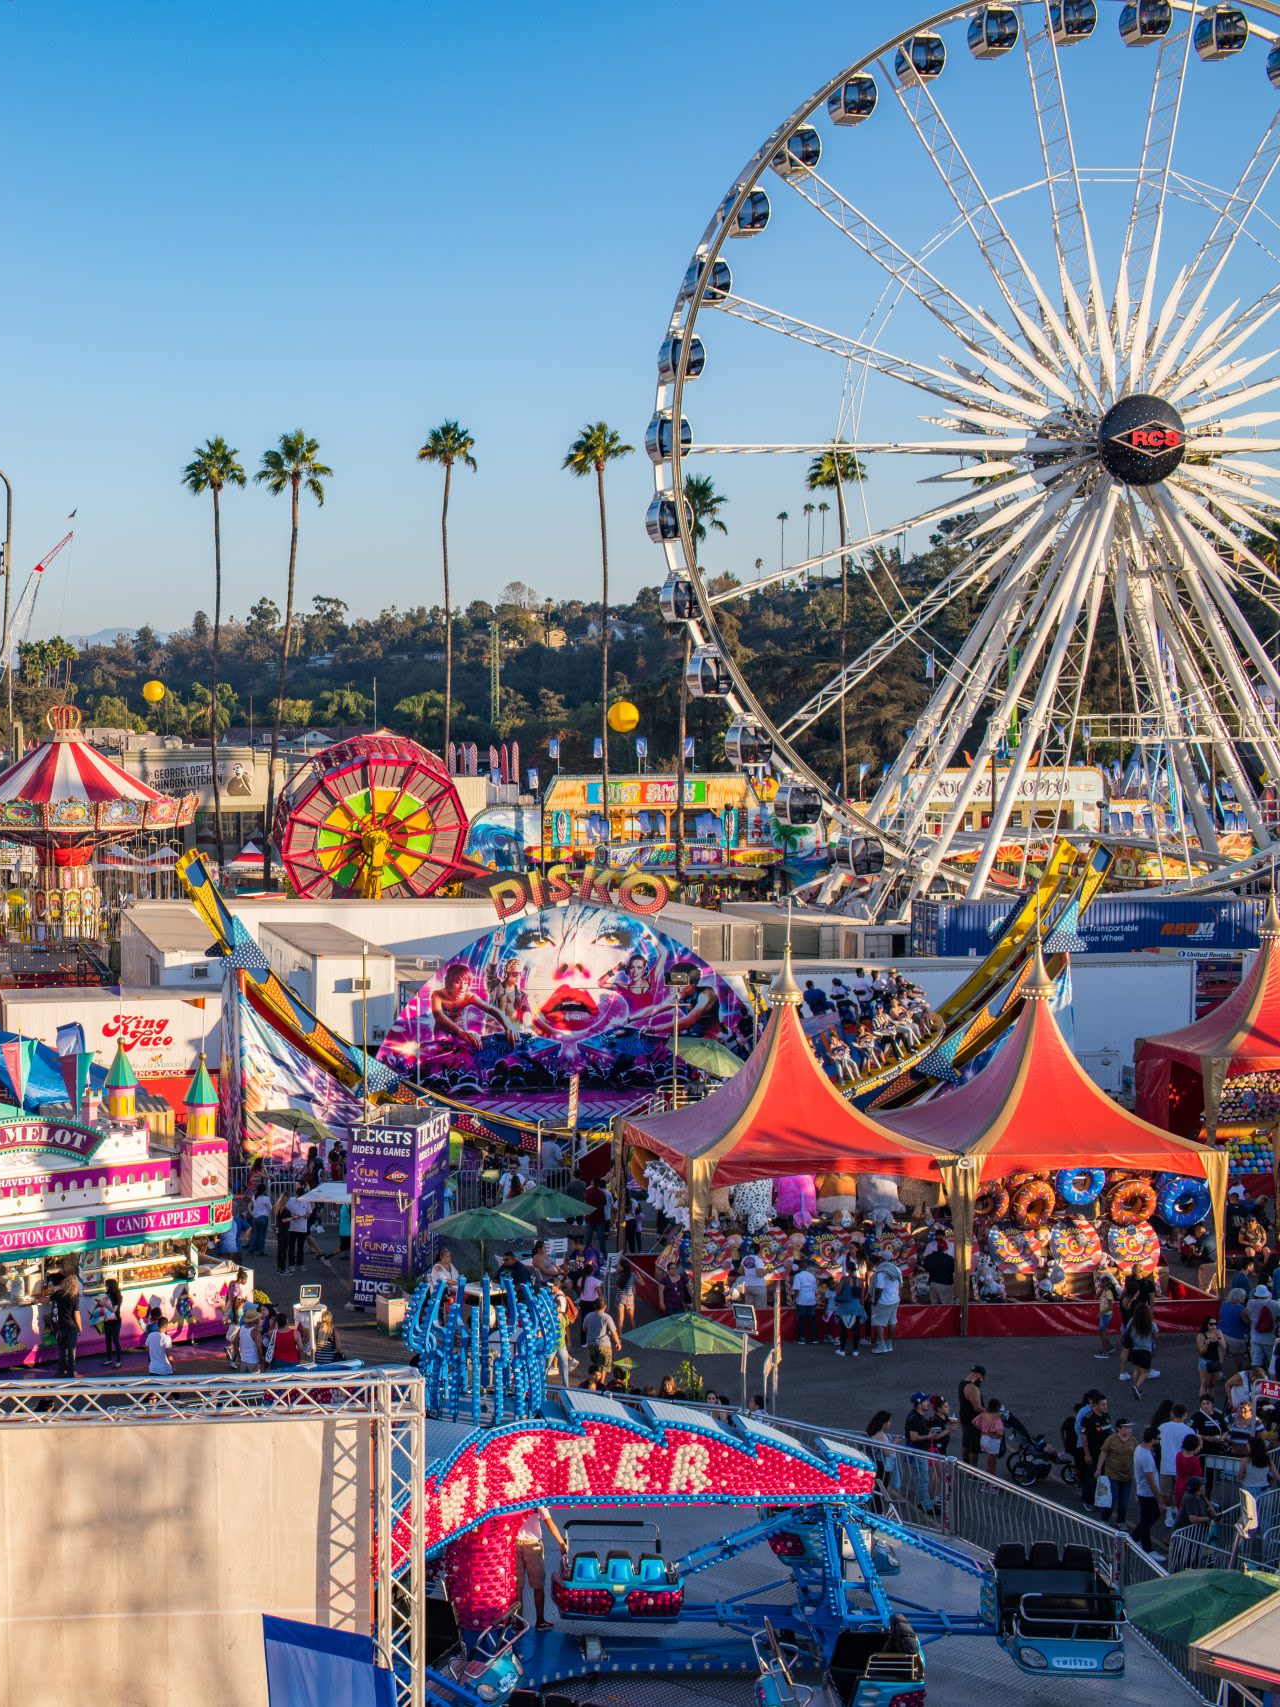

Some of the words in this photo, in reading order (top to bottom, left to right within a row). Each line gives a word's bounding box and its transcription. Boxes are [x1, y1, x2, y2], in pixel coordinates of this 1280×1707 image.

[1133, 431, 1180, 447] RCS
[154, 768, 185, 780] GEORGE
[149, 776, 186, 791] CHINGON
[598, 782, 641, 802] SURF
[489, 863, 669, 920] DISKO
[1090, 924, 1139, 934] Transportable
[1102, 934, 1124, 942] Wheel
[102, 1014, 170, 1038] King
[123, 1030, 173, 1052] Taco
[418, 1113, 450, 1149] TICKETS
[352, 1145, 374, 1155] RIDES
[383, 1148, 410, 1158] GAMES
[360, 1168, 379, 1177] FUN
[34, 1175, 52, 1184] ICE
[116, 1216, 156, 1232] CANDY
[159, 1210, 201, 1227] APPLES
[41, 1225, 86, 1242] CANDY
[1061, 1228, 1083, 1236] BANK
[816, 1233, 838, 1244] BANK
[364, 1242, 407, 1254] FUNPASS
[1066, 1254, 1089, 1262] BALL
[1124, 1254, 1147, 1262] BALL
[354, 1294, 374, 1302] RIDES
